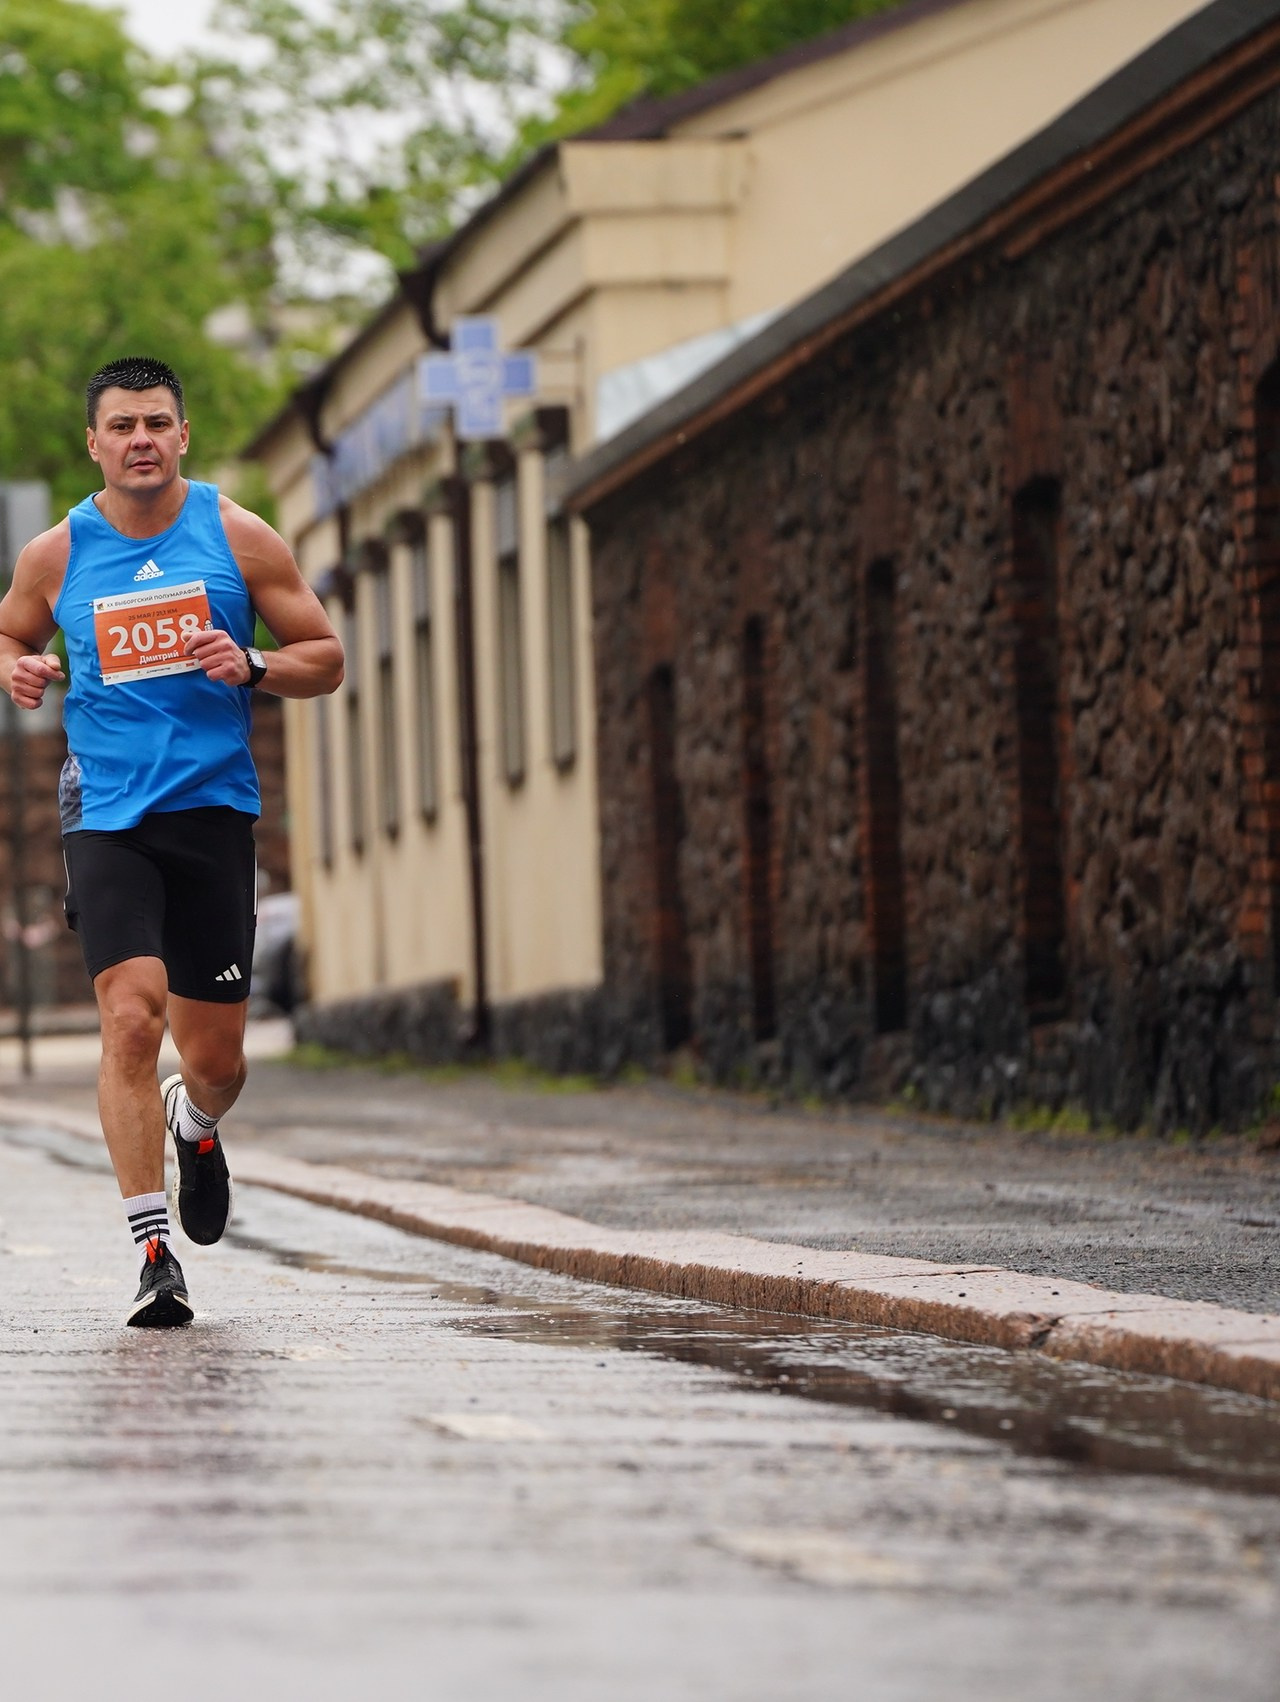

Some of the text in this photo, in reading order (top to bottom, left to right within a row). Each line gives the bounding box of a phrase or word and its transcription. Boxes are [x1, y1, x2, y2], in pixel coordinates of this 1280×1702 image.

[133, 570, 165, 582] adidas
[114, 596, 153, 607] ВЫБОРГСКИЙ
[108, 613, 202, 657] 2058
[139, 649, 179, 665] Дмитрий
